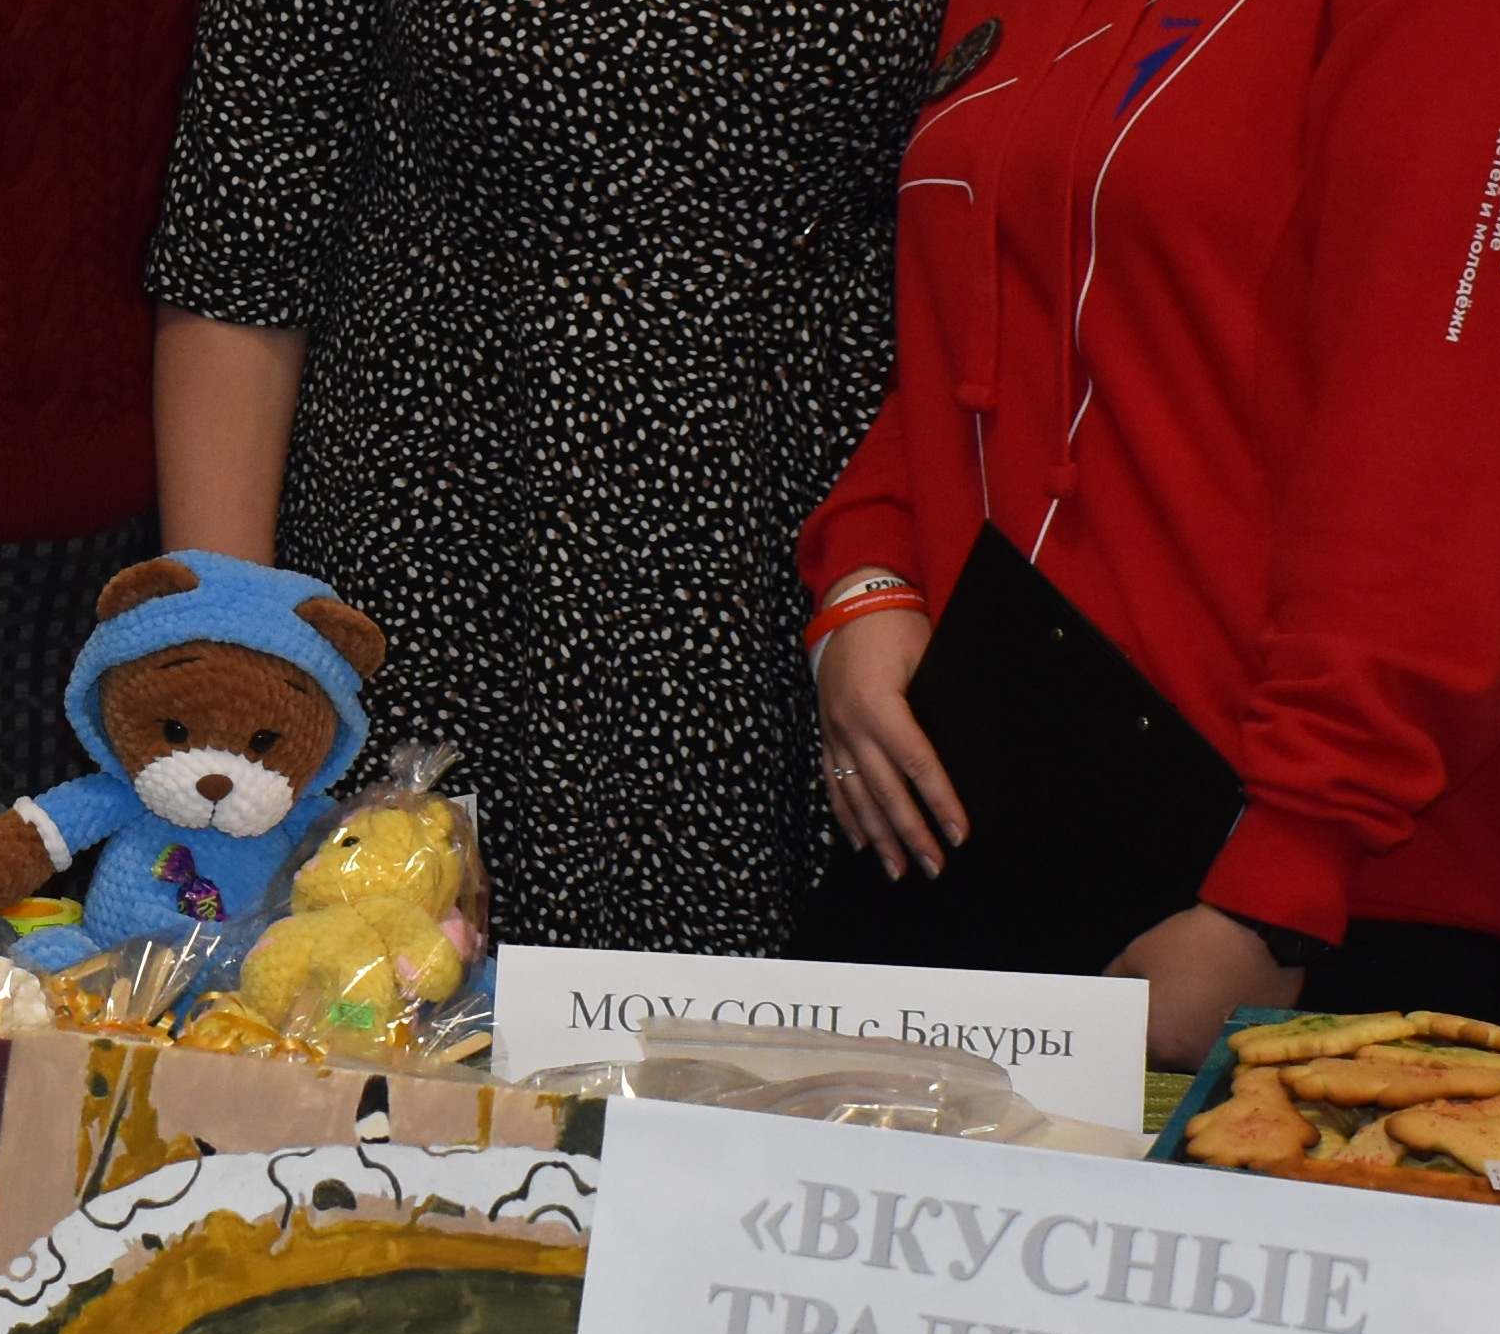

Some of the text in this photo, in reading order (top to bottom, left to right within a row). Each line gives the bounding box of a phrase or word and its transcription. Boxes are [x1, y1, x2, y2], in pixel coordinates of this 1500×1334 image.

[1479, 202, 1494, 218] и
[1445, 223, 1488, 343] молодёжи
[568, 990, 696, 1034] МОУ
[898, 1008, 1075, 1066] Бакуры
